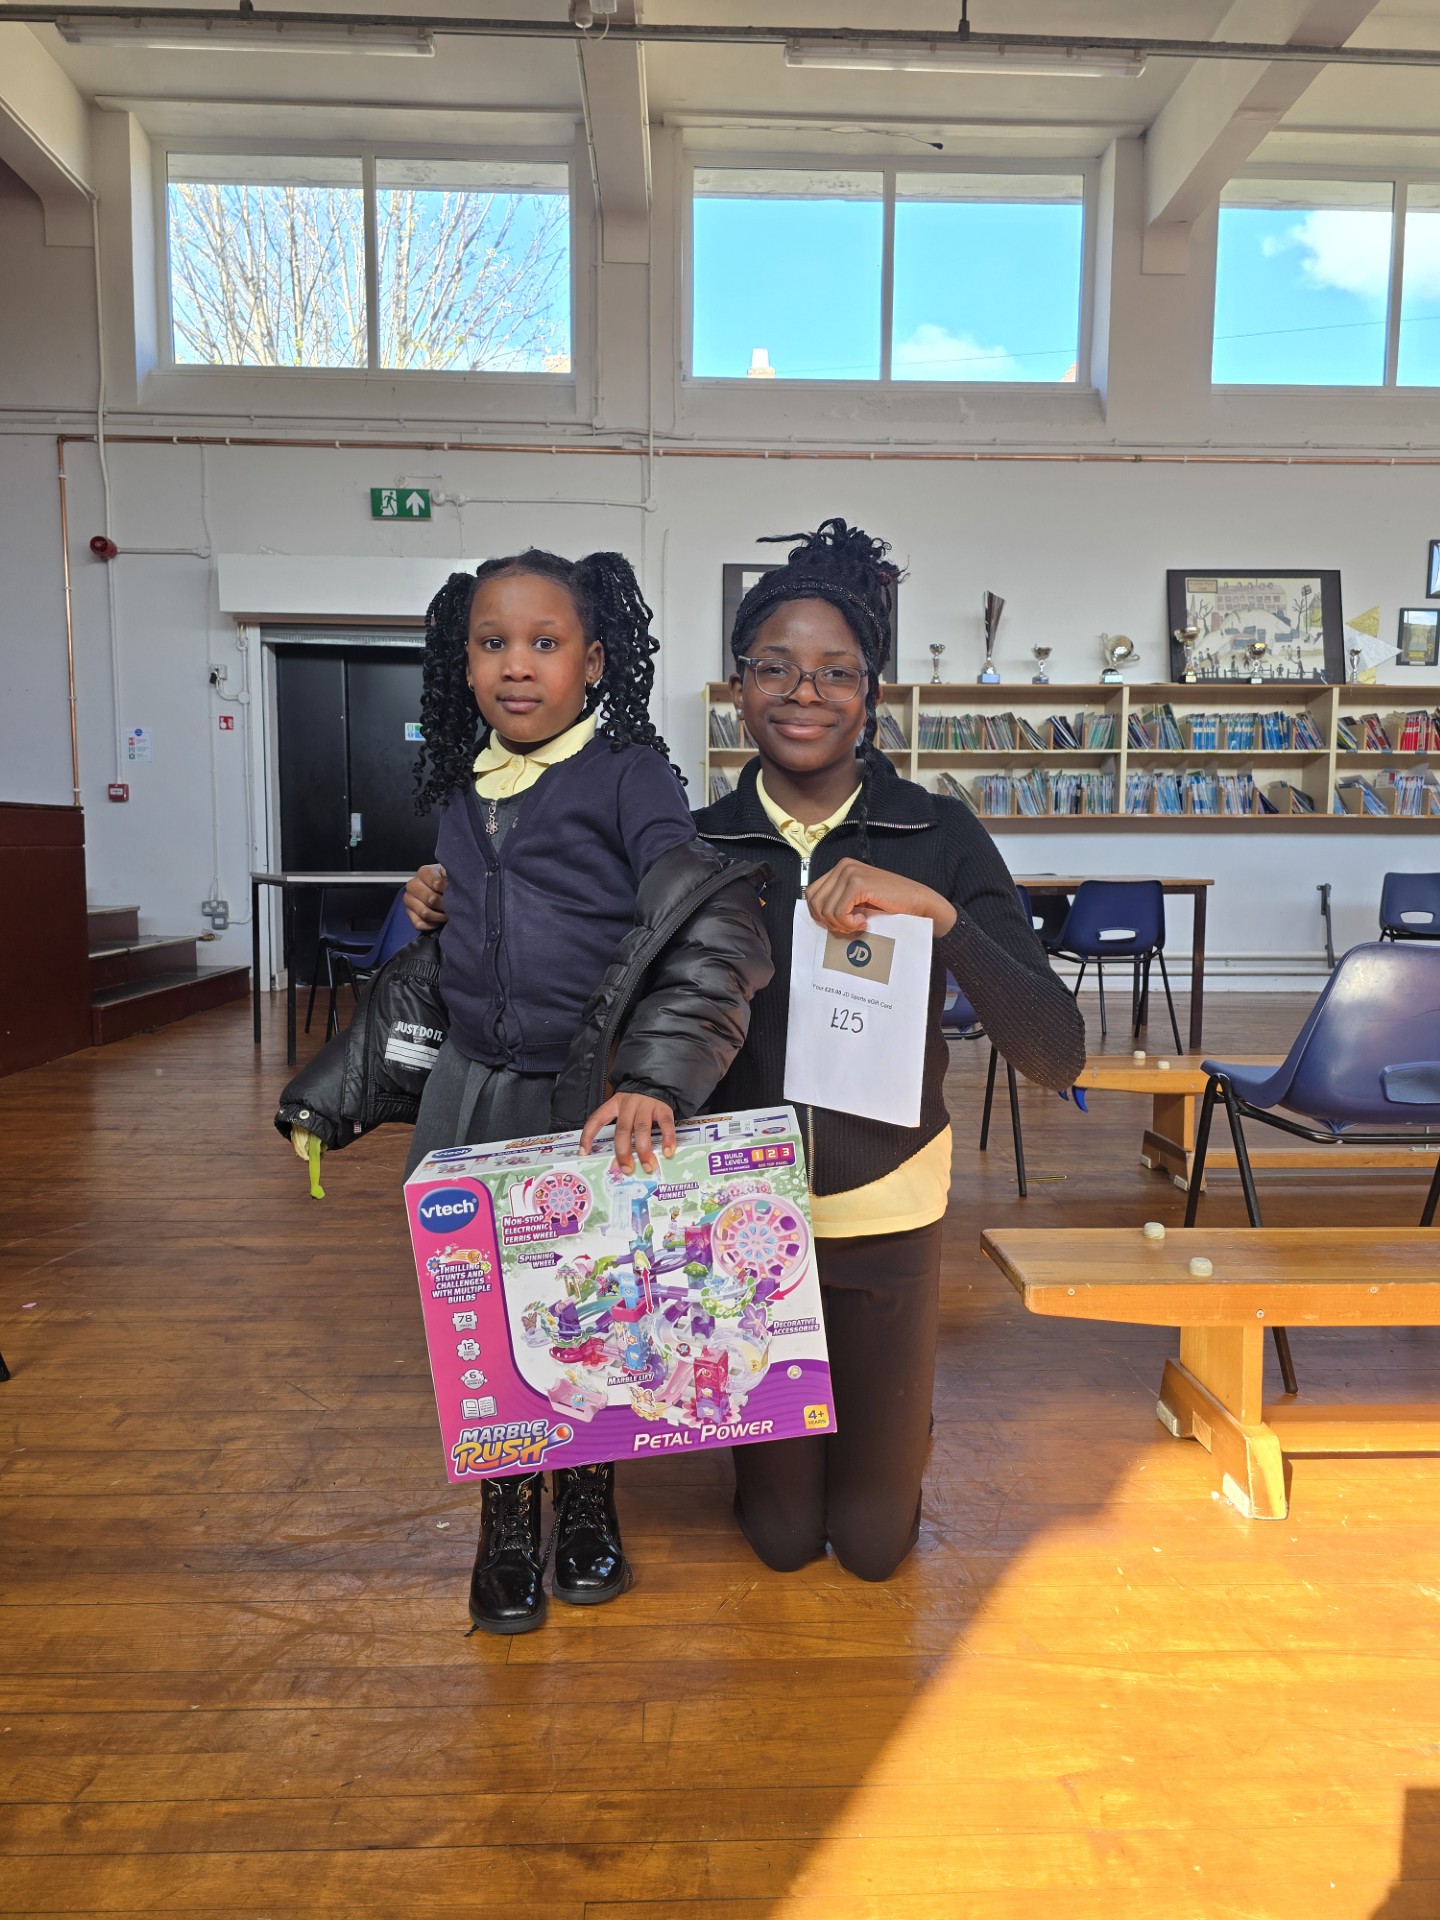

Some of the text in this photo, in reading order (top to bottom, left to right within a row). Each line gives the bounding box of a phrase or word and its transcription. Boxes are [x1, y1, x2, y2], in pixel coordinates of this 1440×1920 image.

[849, 946, 869, 961] JD
[850, 993, 866, 1002] Sports
[868, 998, 880, 1006] eGift
[880, 1002, 892, 1010] Card
[830, 1008, 864, 1034] £25
[394, 1020, 420, 1036] JUST
[418, 1026, 434, 1038] DO
[768, 1150, 776, 1158] 2
[782, 1148, 790, 1156] 3
[711, 1154, 722, 1168] 3
[658, 1182, 698, 1192] WATERFALL
[658, 1191, 686, 1200] FUNNEL
[420, 1199, 476, 1218] vtech
[504, 1216, 544, 1226] NON-STOP
[504, 1224, 548, 1235] ELECTRONIC
[505, 1231, 558, 1244] FERRIS WHEEL
[518, 1253, 554, 1262] SPINNING
[438, 1263, 480, 1274] THRILLING
[532, 1260, 556, 1268] WHEEL
[435, 1270, 484, 1282] STUNTS AND
[436, 1278, 485, 1290] CHALLENGES
[432, 1284, 491, 1298] WITH MULTIPLE
[448, 1295, 476, 1304] BUILDS
[458, 1314, 472, 1324] 78
[774, 1318, 816, 1328] DECORATIVE
[772, 1324, 819, 1336] ACCESSORIES
[463, 1342, 474, 1350] 12
[608, 1373, 653, 1385] MARBLE LIFT
[808, 1409, 824, 1420] 4+
[461, 1420, 547, 1443] MARBLE
[633, 1420, 774, 1452] PETAL POWER
[454, 1436, 548, 1473] RUSH
